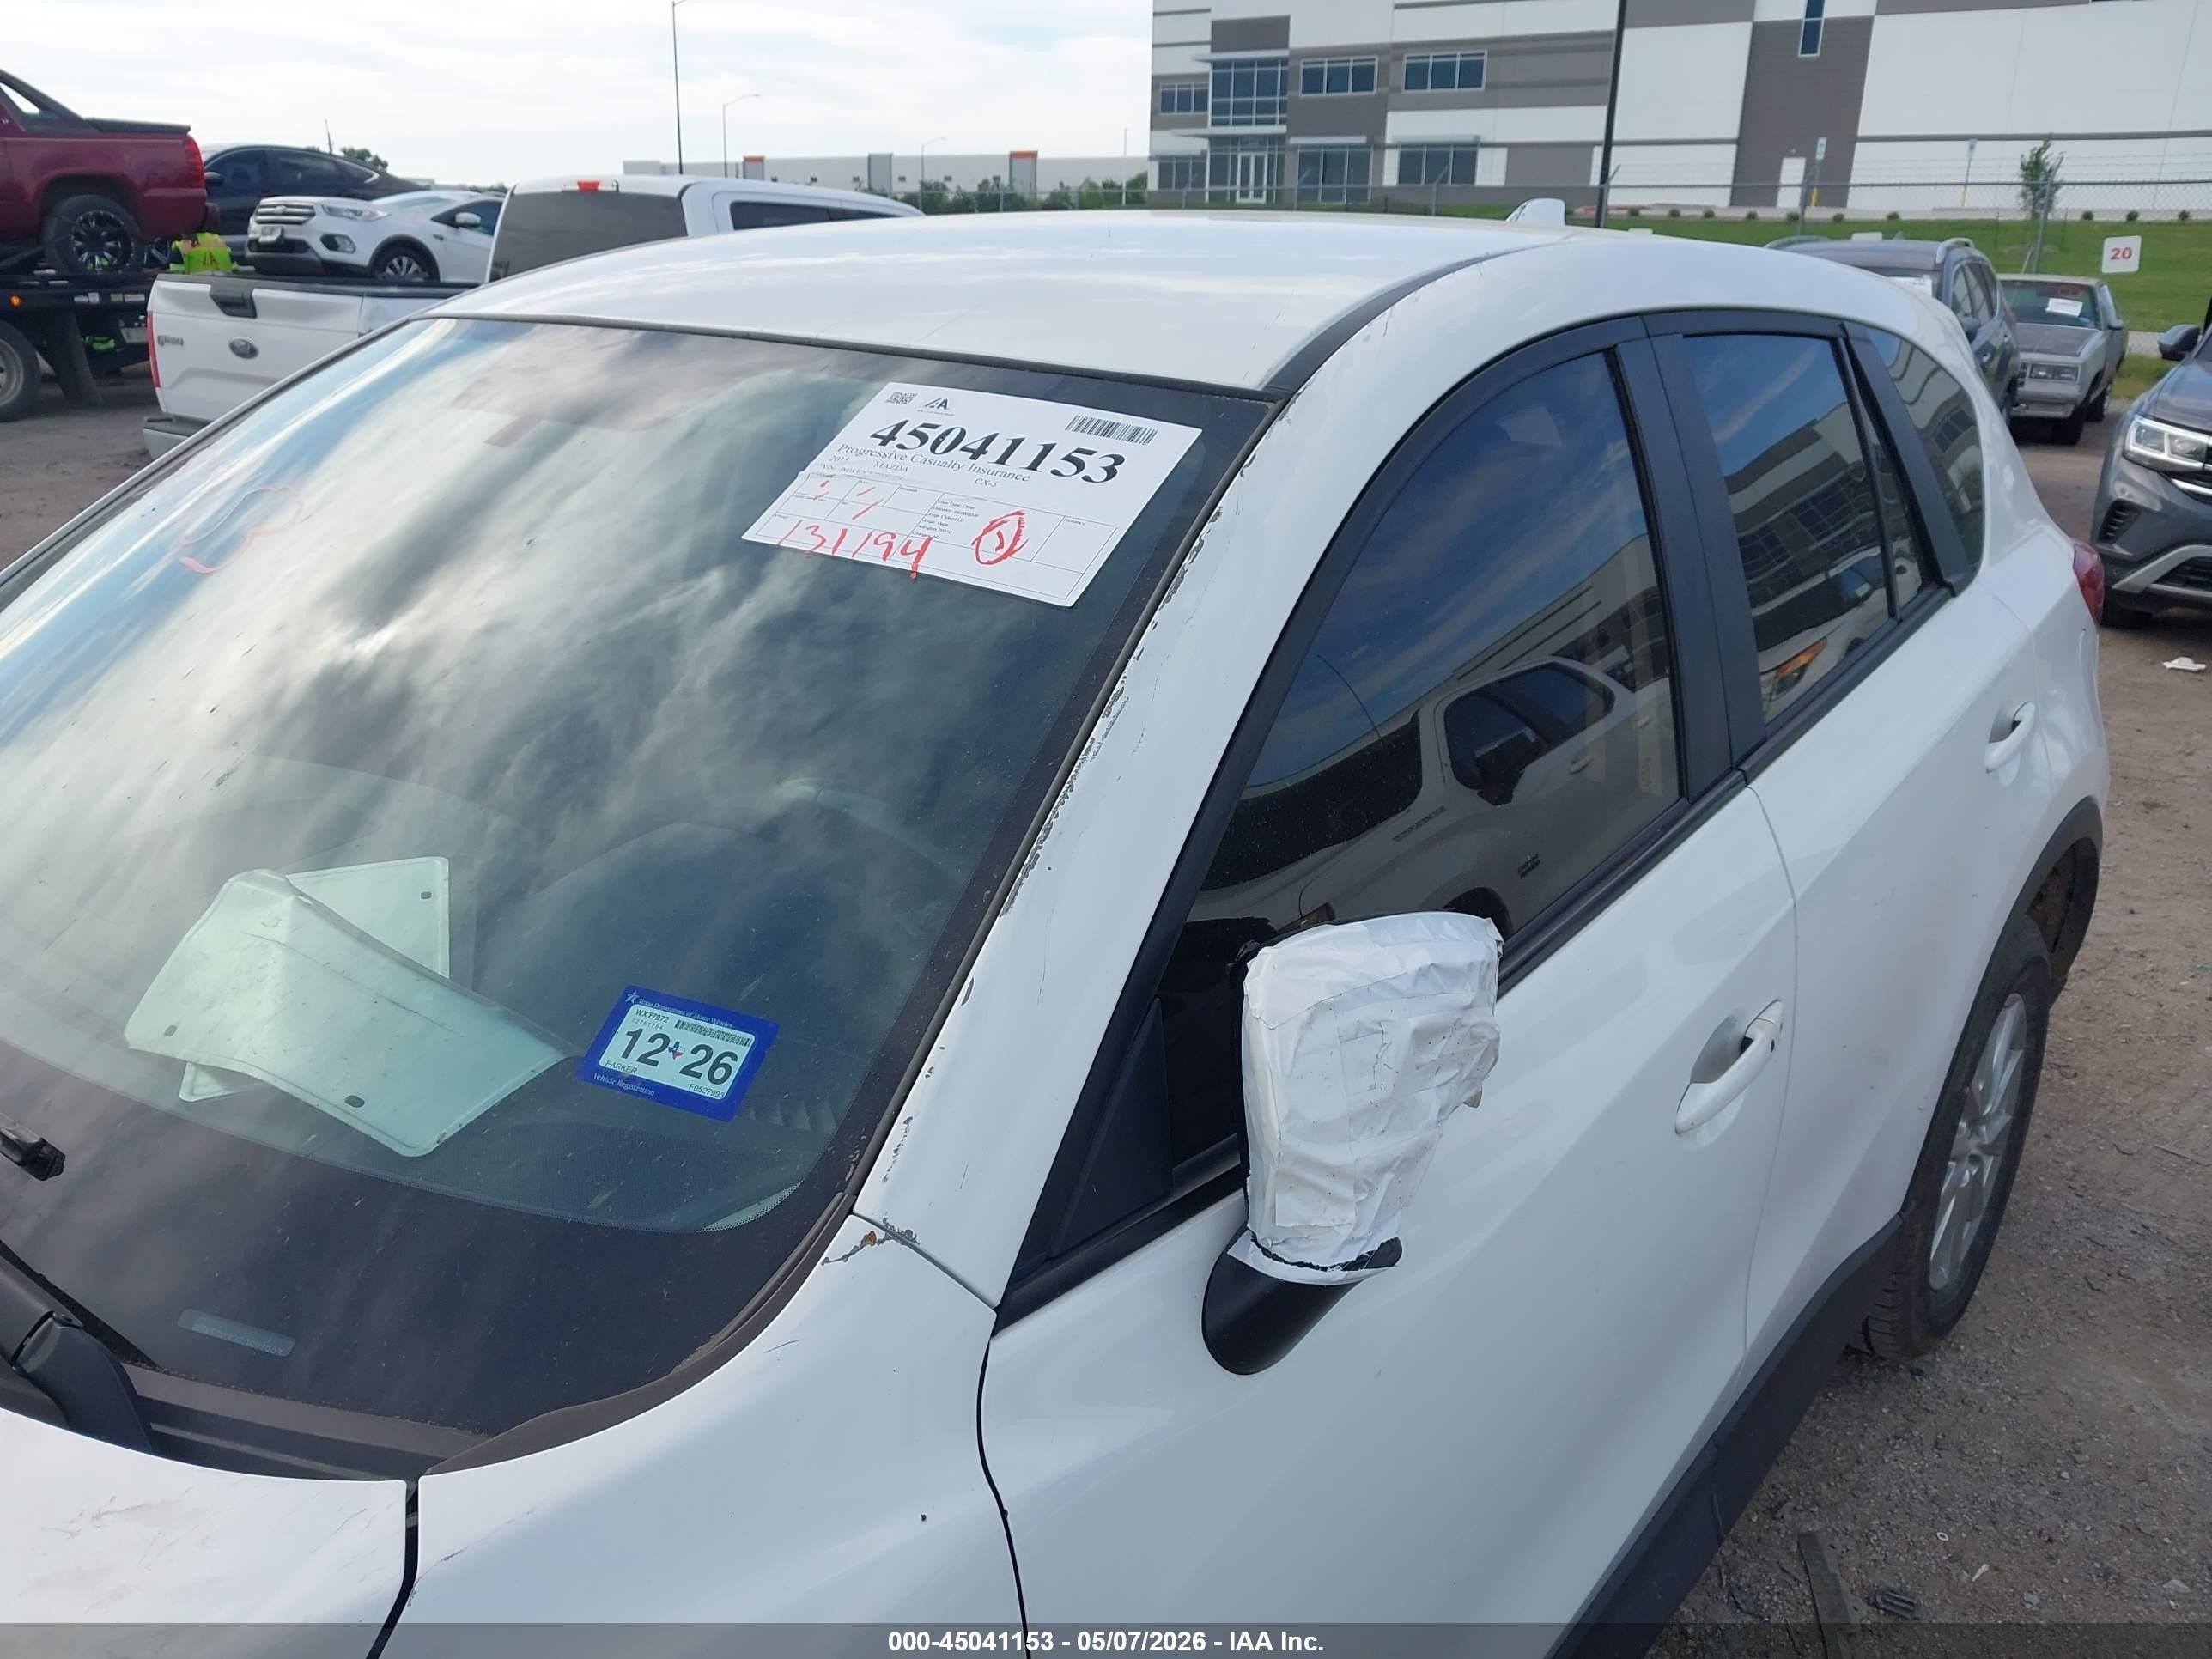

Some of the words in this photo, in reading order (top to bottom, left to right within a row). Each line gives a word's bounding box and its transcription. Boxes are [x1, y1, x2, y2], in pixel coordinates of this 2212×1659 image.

[2110, 246, 2133, 260] 20
[837, 443, 908, 461] Progressive
[910, 453, 967, 472] Casualty
[968, 463, 1030, 483] Insurance
[870, 419, 1126, 483] 45041153
[873, 460, 908, 472] MAZDA
[974, 477, 998, 488] CX-5
[605, 1060, 638, 1074] PARKER
[620, 1028, 671, 1067] 12
[679, 1043, 738, 1085] 26
[593, 1072, 617, 1086] Vehicle
[617, 1079, 655, 1097] Registration
[688, 1083, 725, 1100] F0527993
